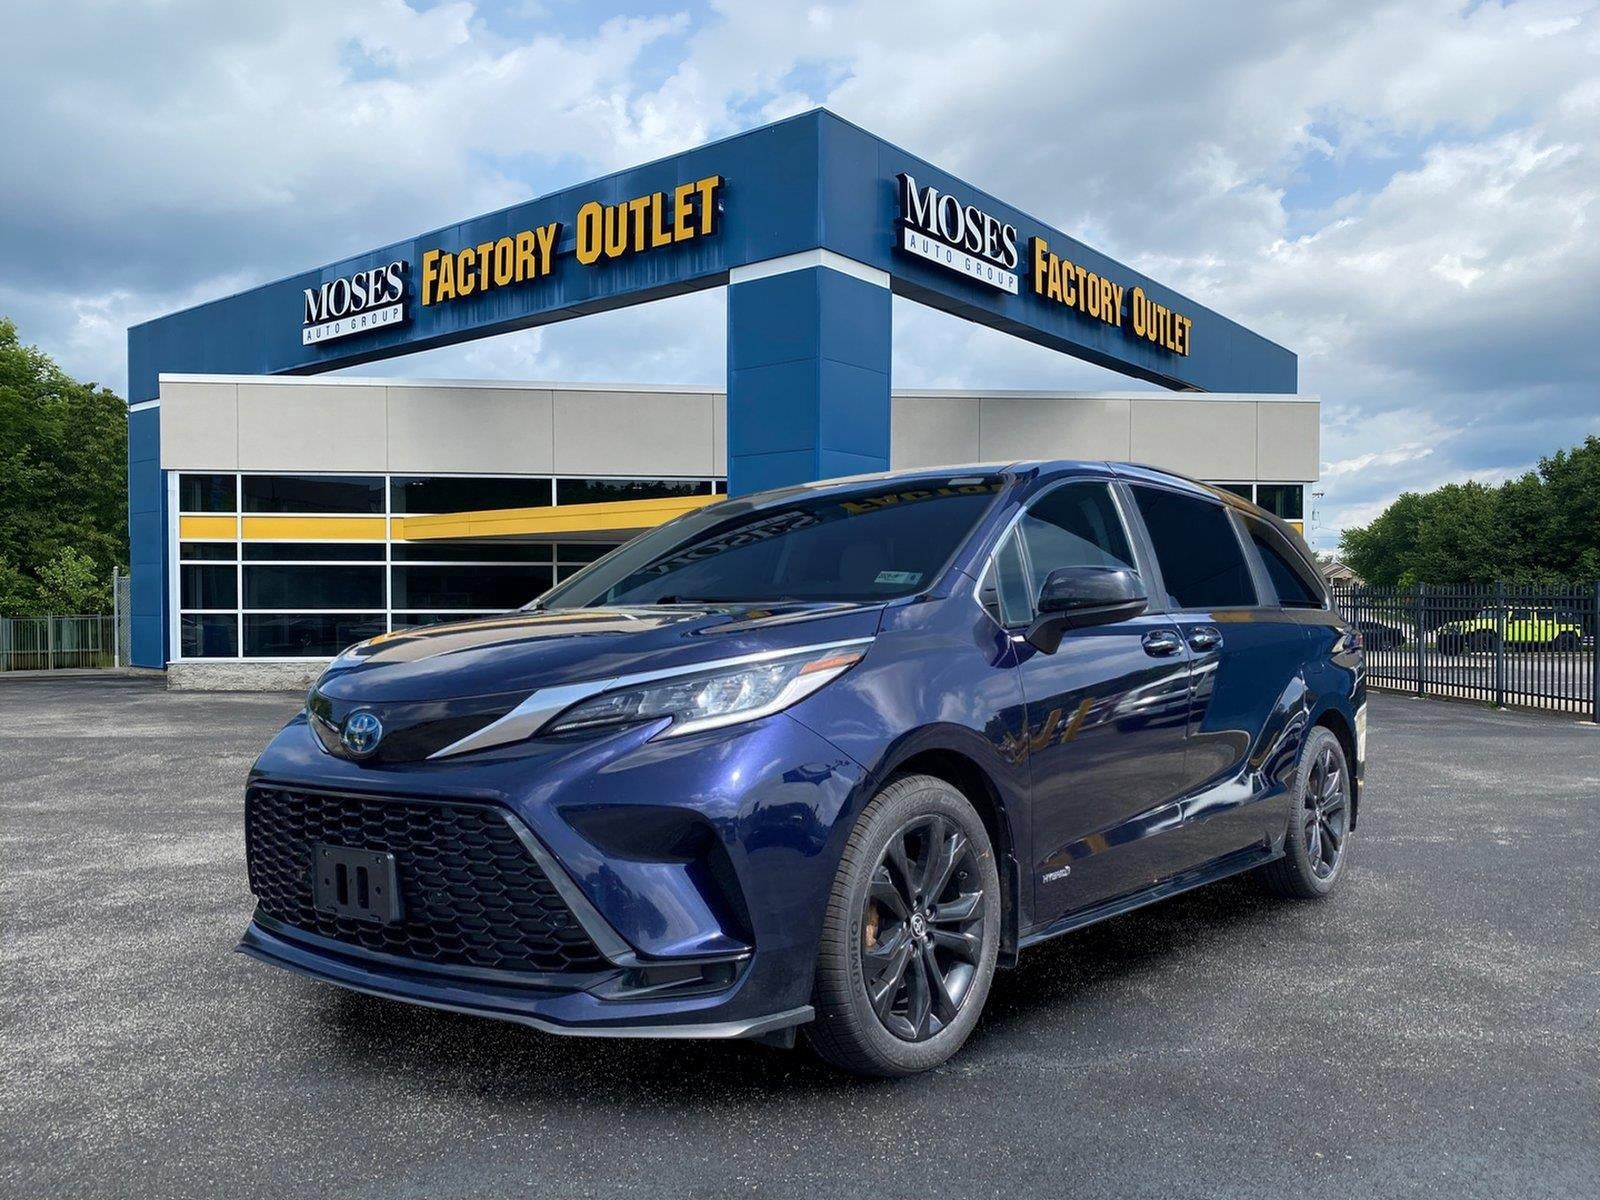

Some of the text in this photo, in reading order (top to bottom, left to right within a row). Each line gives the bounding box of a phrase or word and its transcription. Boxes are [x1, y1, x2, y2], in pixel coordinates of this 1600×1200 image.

[422, 175, 720, 306] FACTORY OUTLET
[904, 173, 1018, 269] MOSES
[303, 260, 403, 325] MOSES
[909, 234, 1014, 289] AUTO GROUP
[1035, 236, 1192, 356] FACTORY OUTLET
[306, 307, 399, 341] AUTO GROUP
